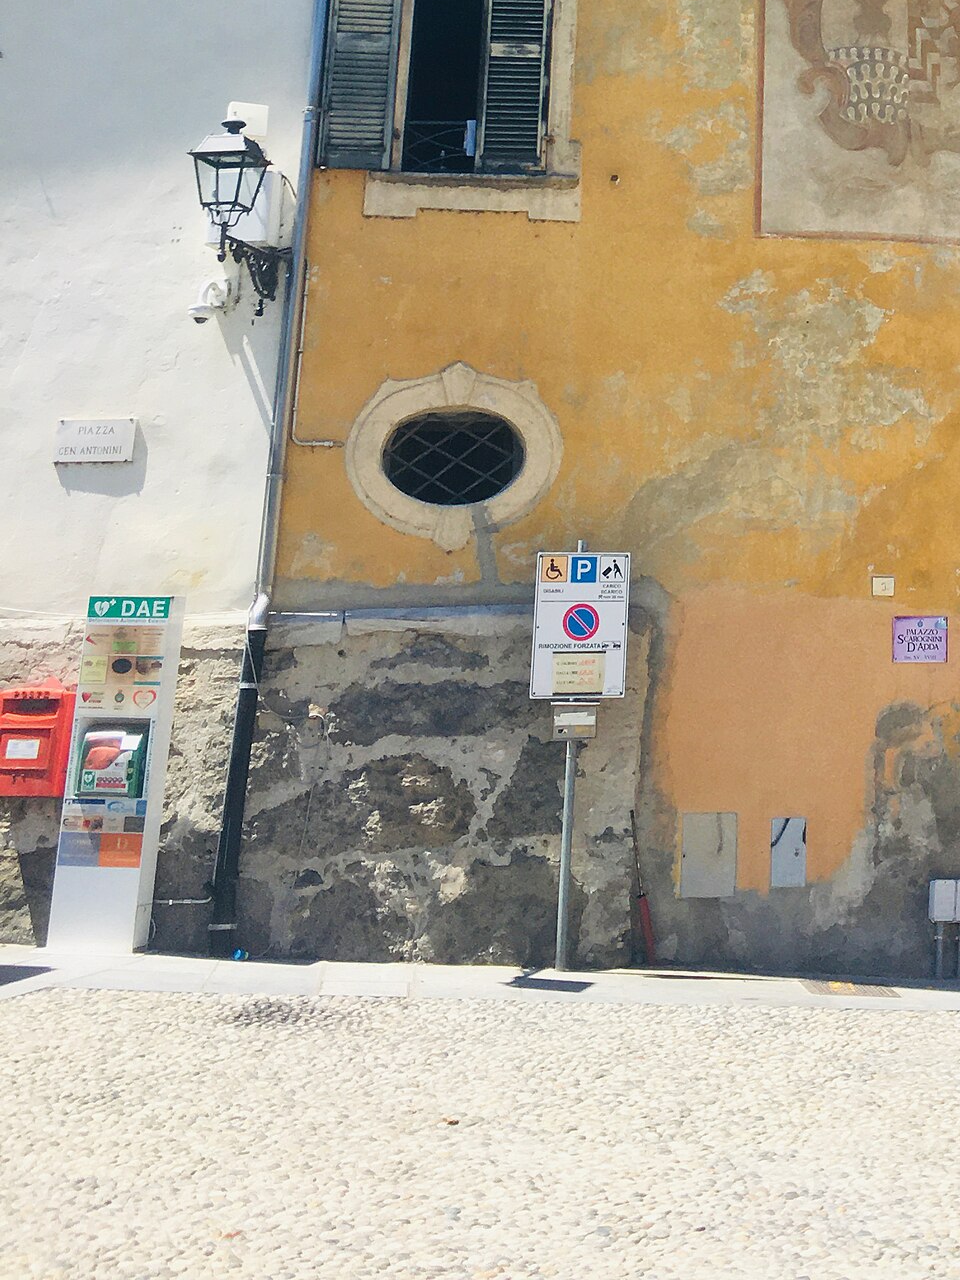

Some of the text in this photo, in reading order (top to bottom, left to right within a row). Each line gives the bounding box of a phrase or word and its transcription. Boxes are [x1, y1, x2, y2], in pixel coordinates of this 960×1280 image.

[77, 426, 116, 436] PIAZZA
[79, 445, 122, 456] ANTONINI
[121, 600, 166, 617] DAE
[906, 628, 939, 636] PALAZZO
